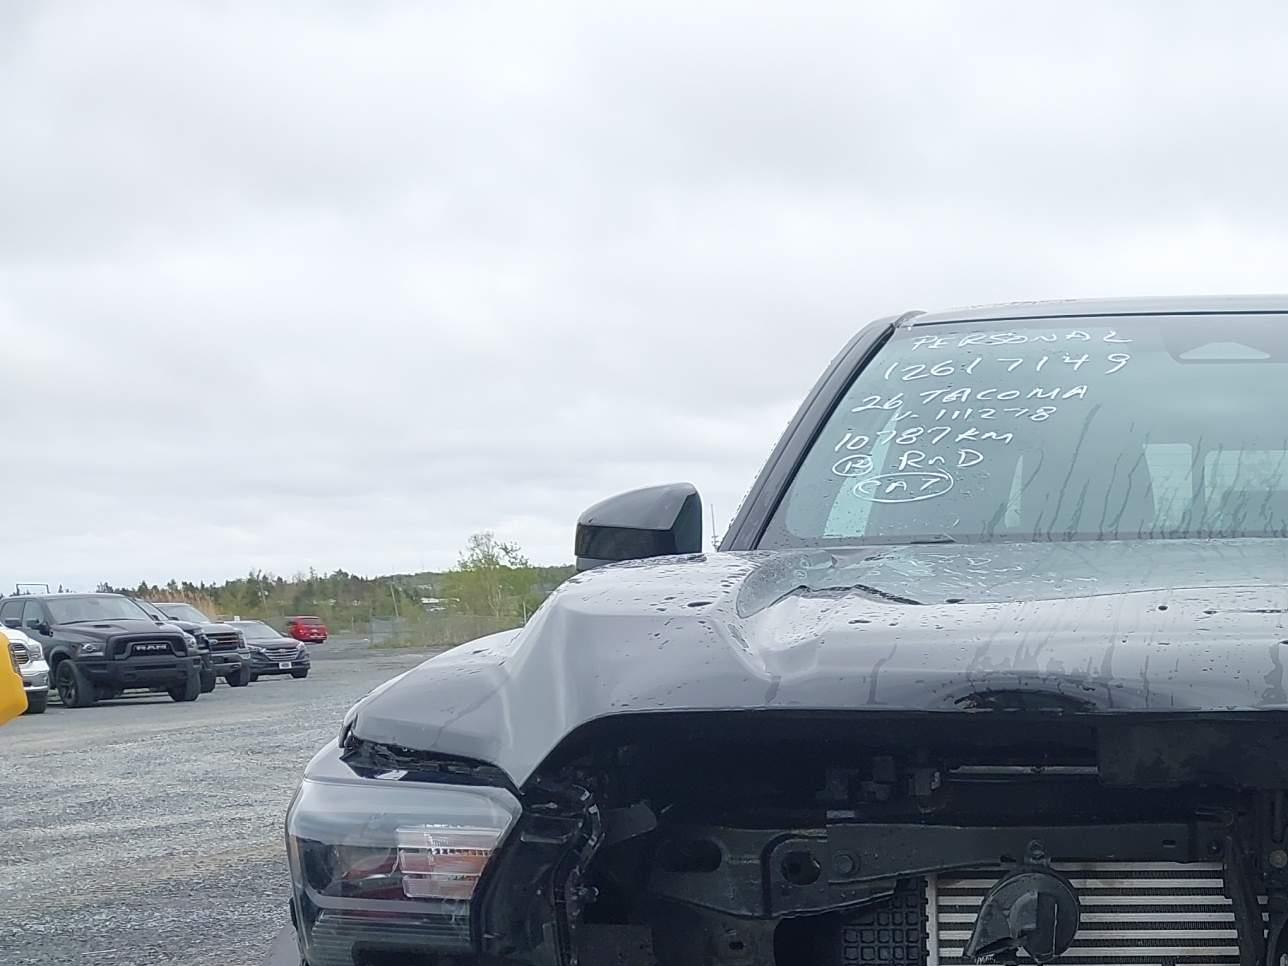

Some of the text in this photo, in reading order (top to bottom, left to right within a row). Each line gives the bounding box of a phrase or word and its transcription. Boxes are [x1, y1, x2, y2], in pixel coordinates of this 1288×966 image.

[884, 353, 1131, 381] 12617149
[851, 385, 1088, 413] 26 TACOMA
